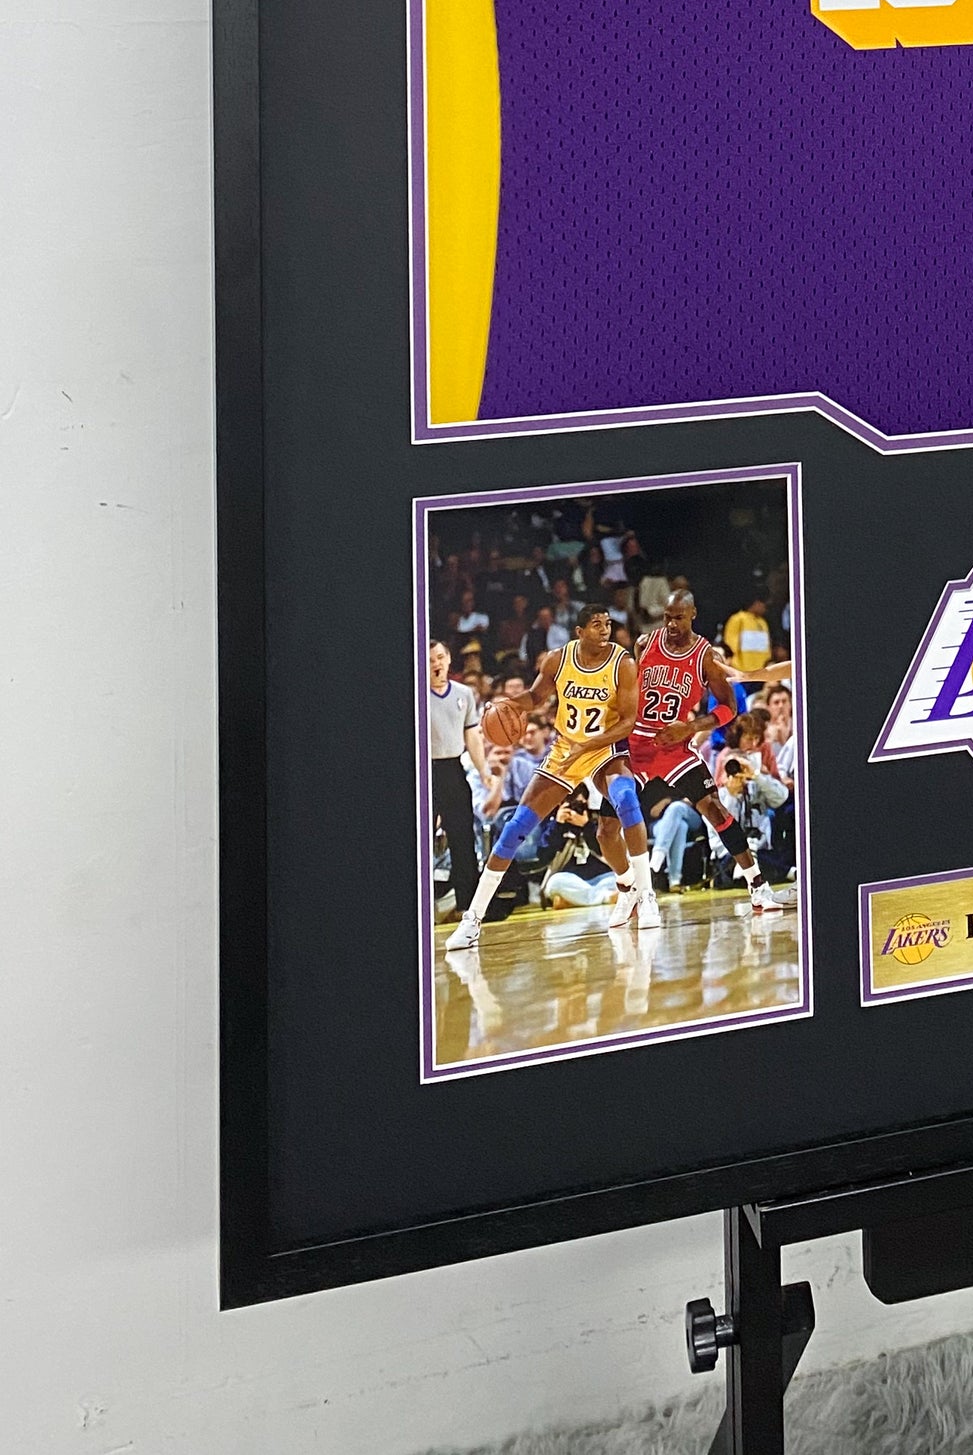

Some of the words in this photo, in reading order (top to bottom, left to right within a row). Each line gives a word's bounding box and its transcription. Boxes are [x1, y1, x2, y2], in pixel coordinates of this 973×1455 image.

[564, 680, 609, 701] LAKERS
[642, 665, 693, 698] BULLS
[565, 702, 606, 737] 32
[643, 690, 682, 723] 23
[880, 927, 951, 956] LAKERS
